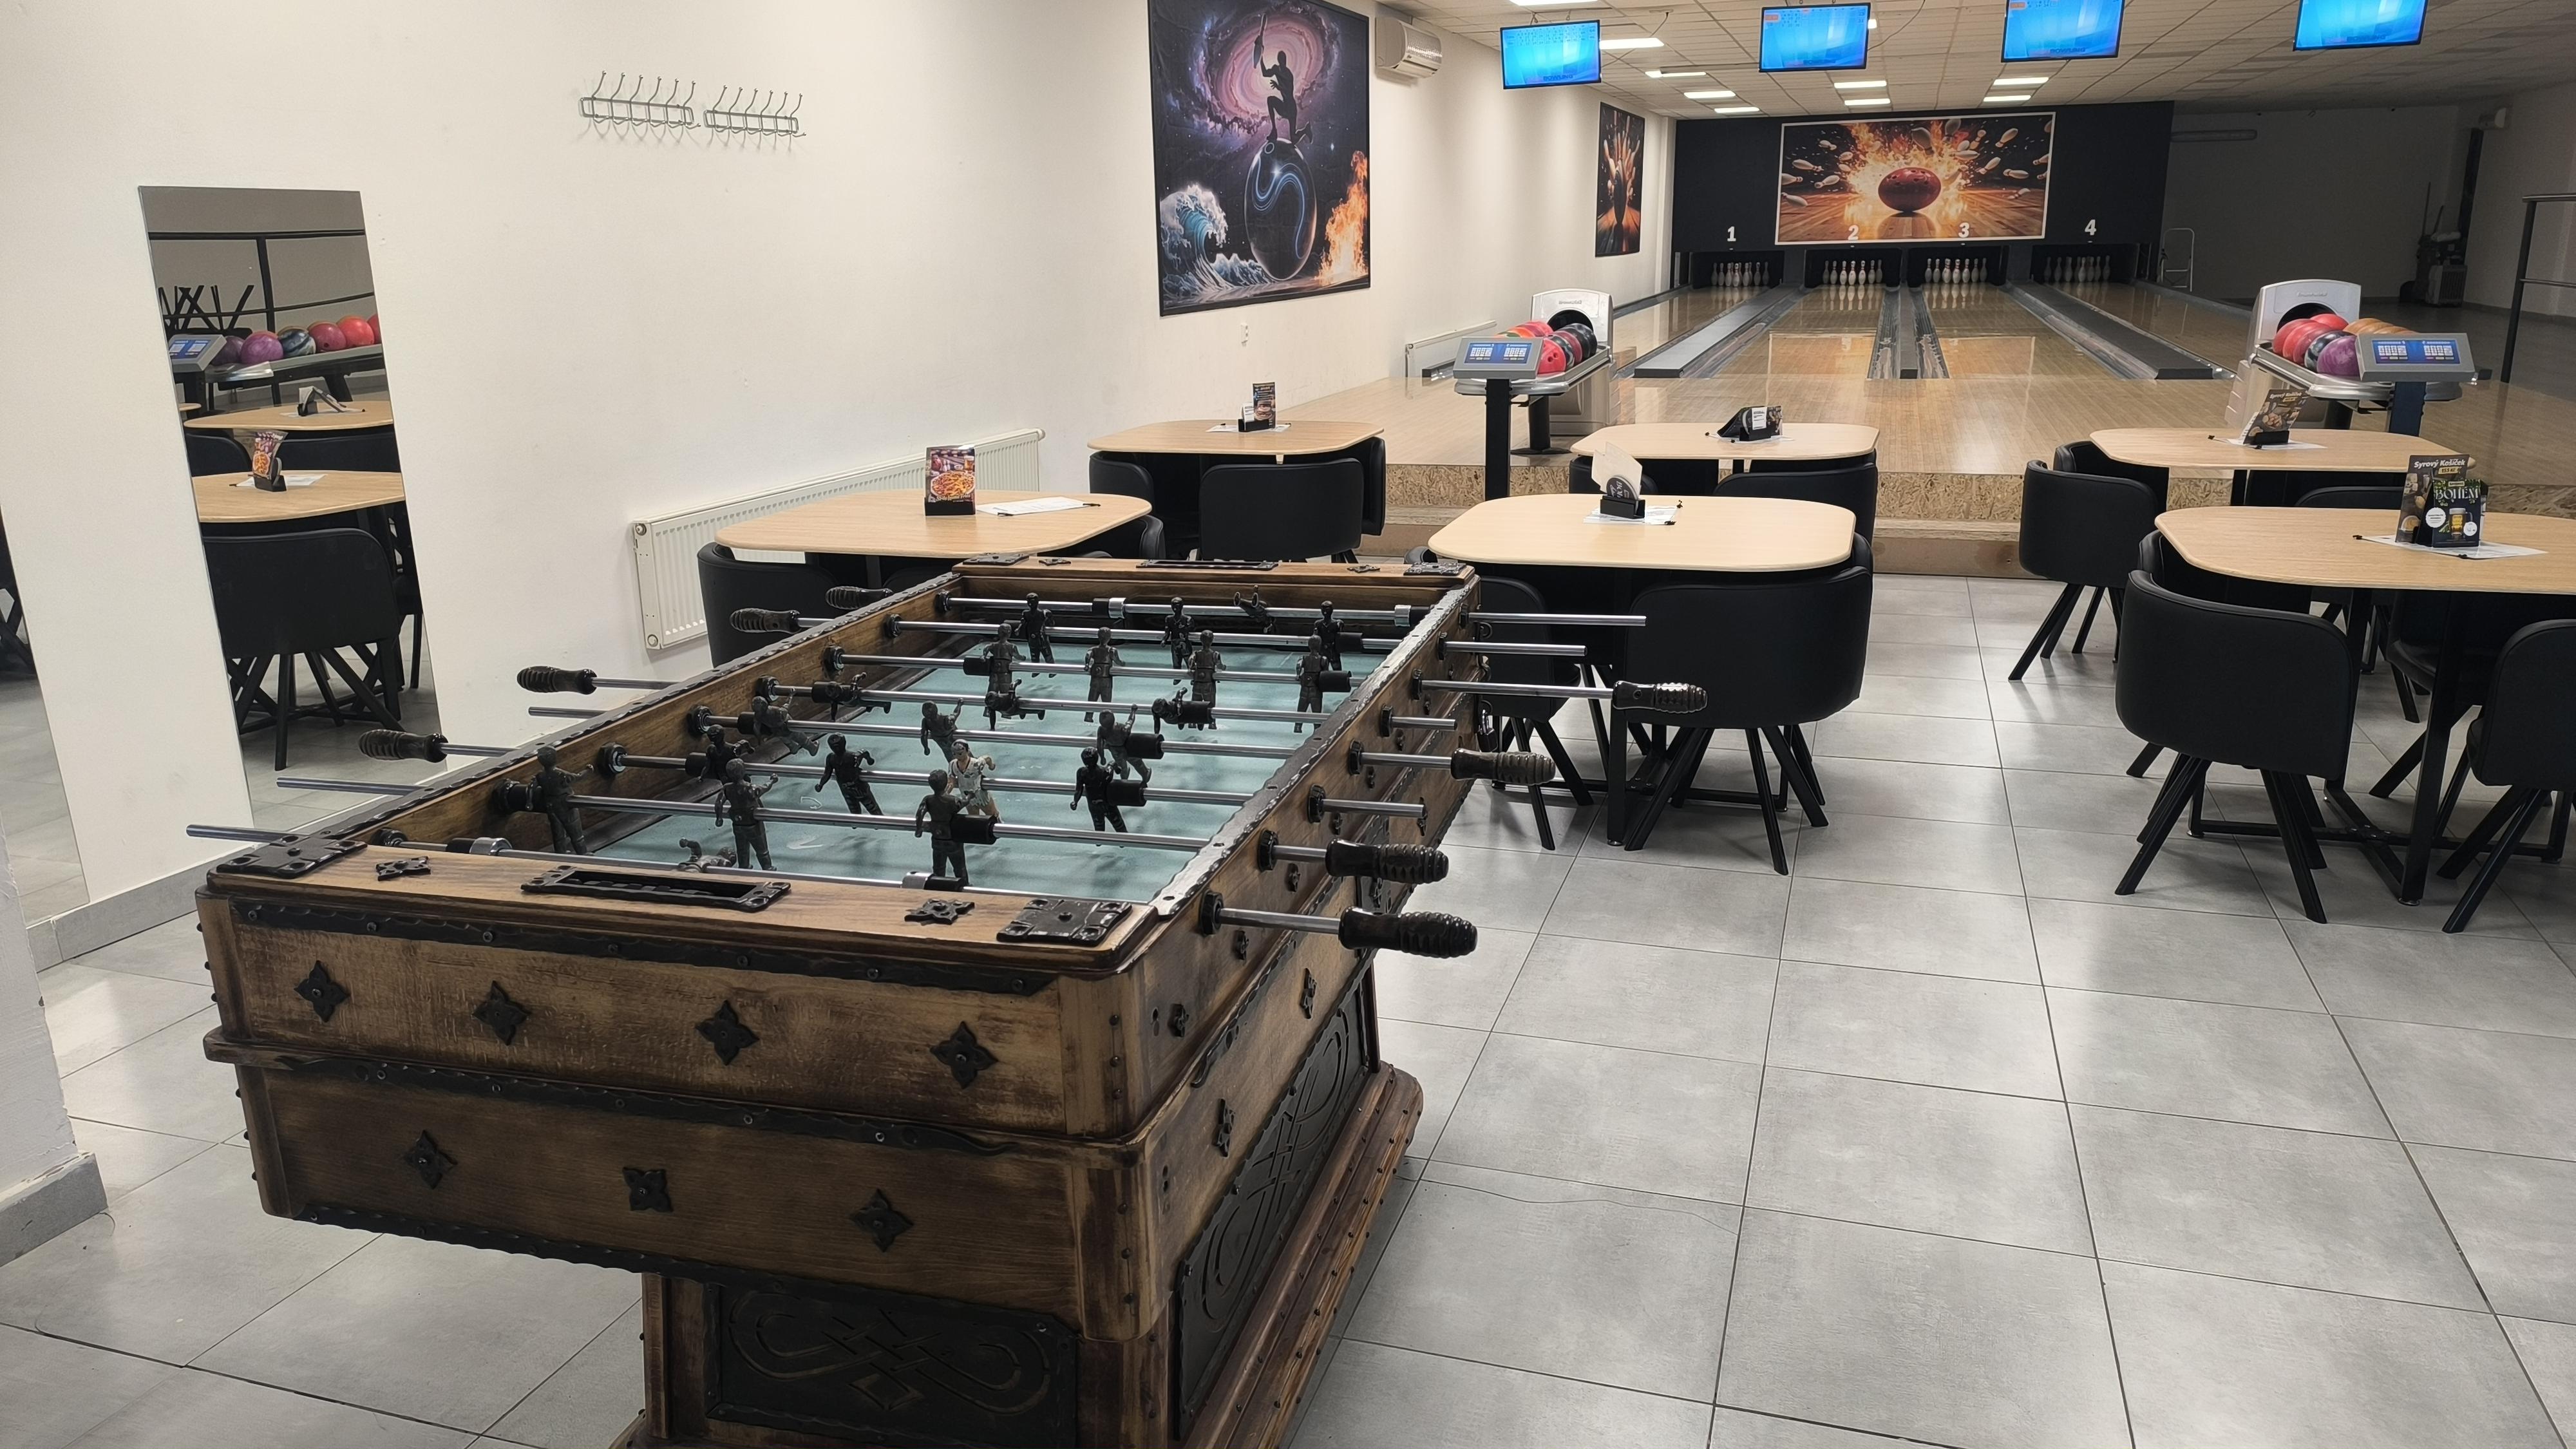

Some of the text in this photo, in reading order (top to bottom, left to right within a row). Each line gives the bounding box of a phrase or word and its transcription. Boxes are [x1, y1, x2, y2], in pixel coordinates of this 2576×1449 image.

[1727, 226, 1736, 242] 1
[1848, 225, 1859, 240] 2
[1958, 222, 1969, 238] 3
[2085, 219, 2096, 235] 4
[2414, 459, 2439, 469] Syrový
[2436, 486, 2479, 500] BOHÉM
